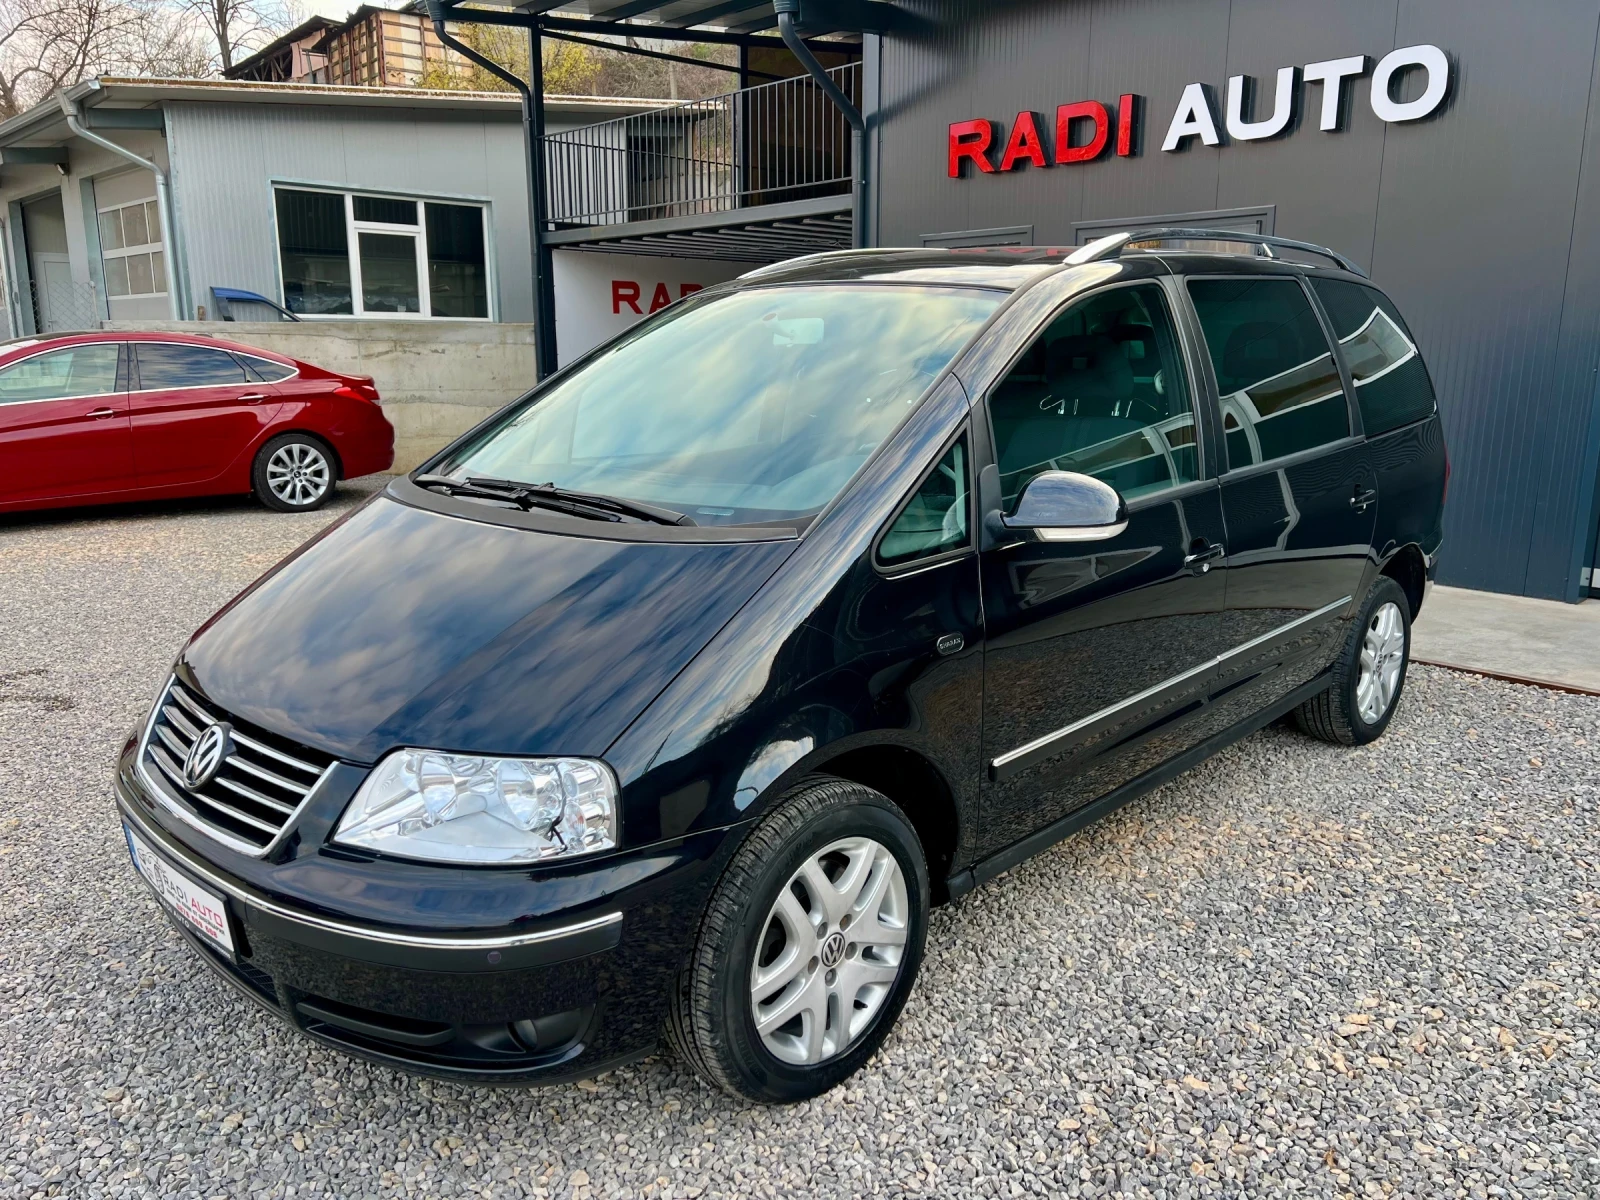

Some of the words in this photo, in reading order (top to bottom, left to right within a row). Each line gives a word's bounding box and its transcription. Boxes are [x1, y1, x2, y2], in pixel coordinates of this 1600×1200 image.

[948, 93, 1138, 178] RADI
[1161, 44, 1450, 152] AUTO
[163, 874, 188, 904] RADI
[191, 897, 224, 928] AUTO
